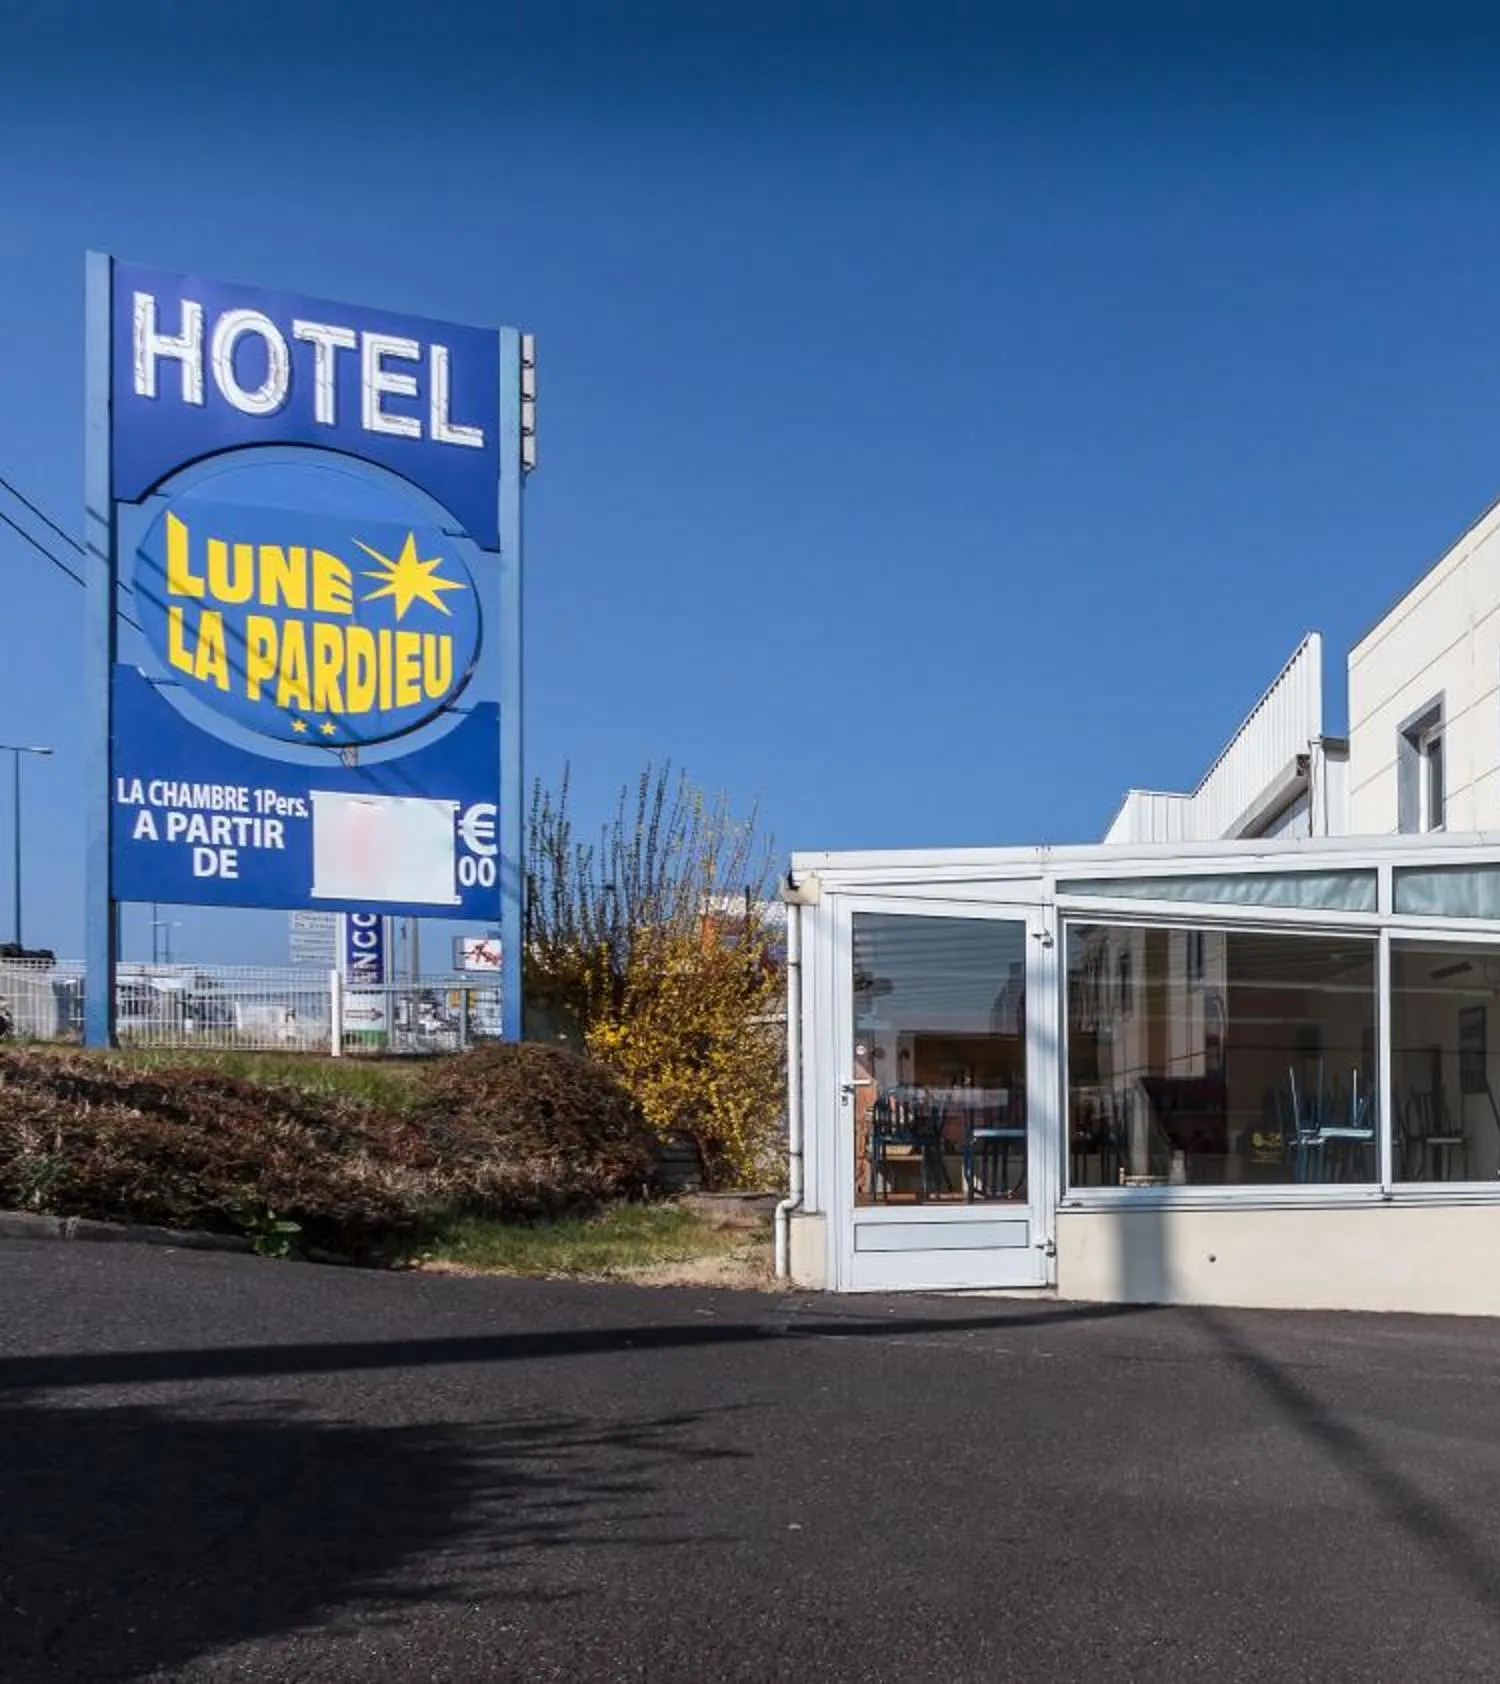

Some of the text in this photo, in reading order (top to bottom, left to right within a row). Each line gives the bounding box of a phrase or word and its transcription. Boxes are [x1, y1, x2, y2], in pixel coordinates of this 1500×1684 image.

[132, 291, 485, 448] HOTEL
[165, 509, 353, 615] LUNE
[167, 606, 453, 714] LA PARDIEU
[117, 777, 309, 818] LA CHAMBRE 1Pers.
[132, 809, 285, 849] A PARTIR
[457, 803, 498, 856] €
[192, 848, 239, 879] DE
[458, 855, 497, 887] 00
